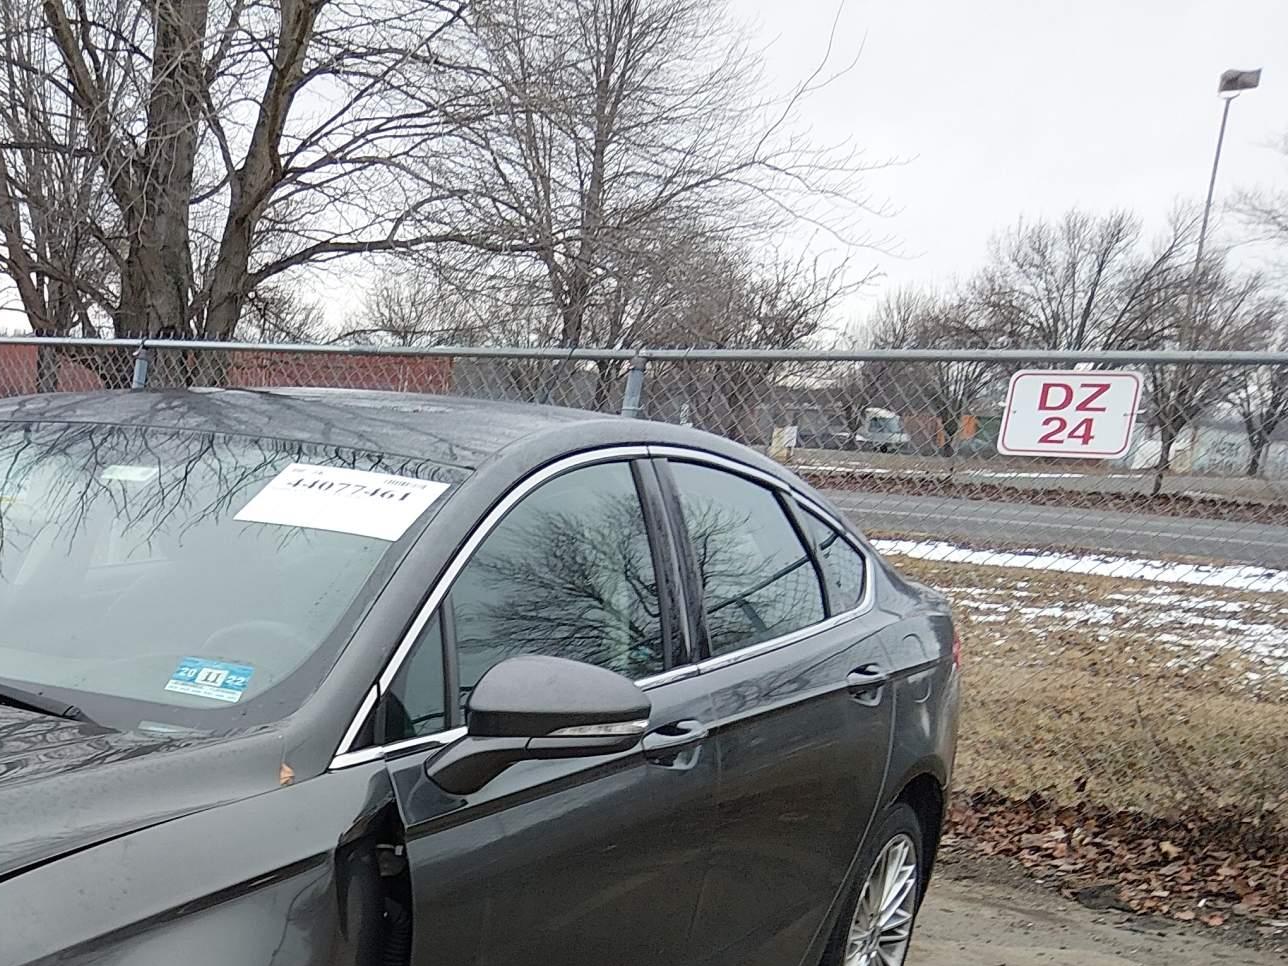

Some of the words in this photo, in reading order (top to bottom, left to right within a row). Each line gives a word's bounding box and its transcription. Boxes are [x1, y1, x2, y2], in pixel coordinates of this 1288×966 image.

[1038, 383, 1112, 412] DZ
[1038, 416, 1095, 445] 24
[287, 478, 411, 502] 44077461
[179, 667, 197, 678] 20
[201, 671, 222, 684] 11
[226, 675, 247, 686] 22
